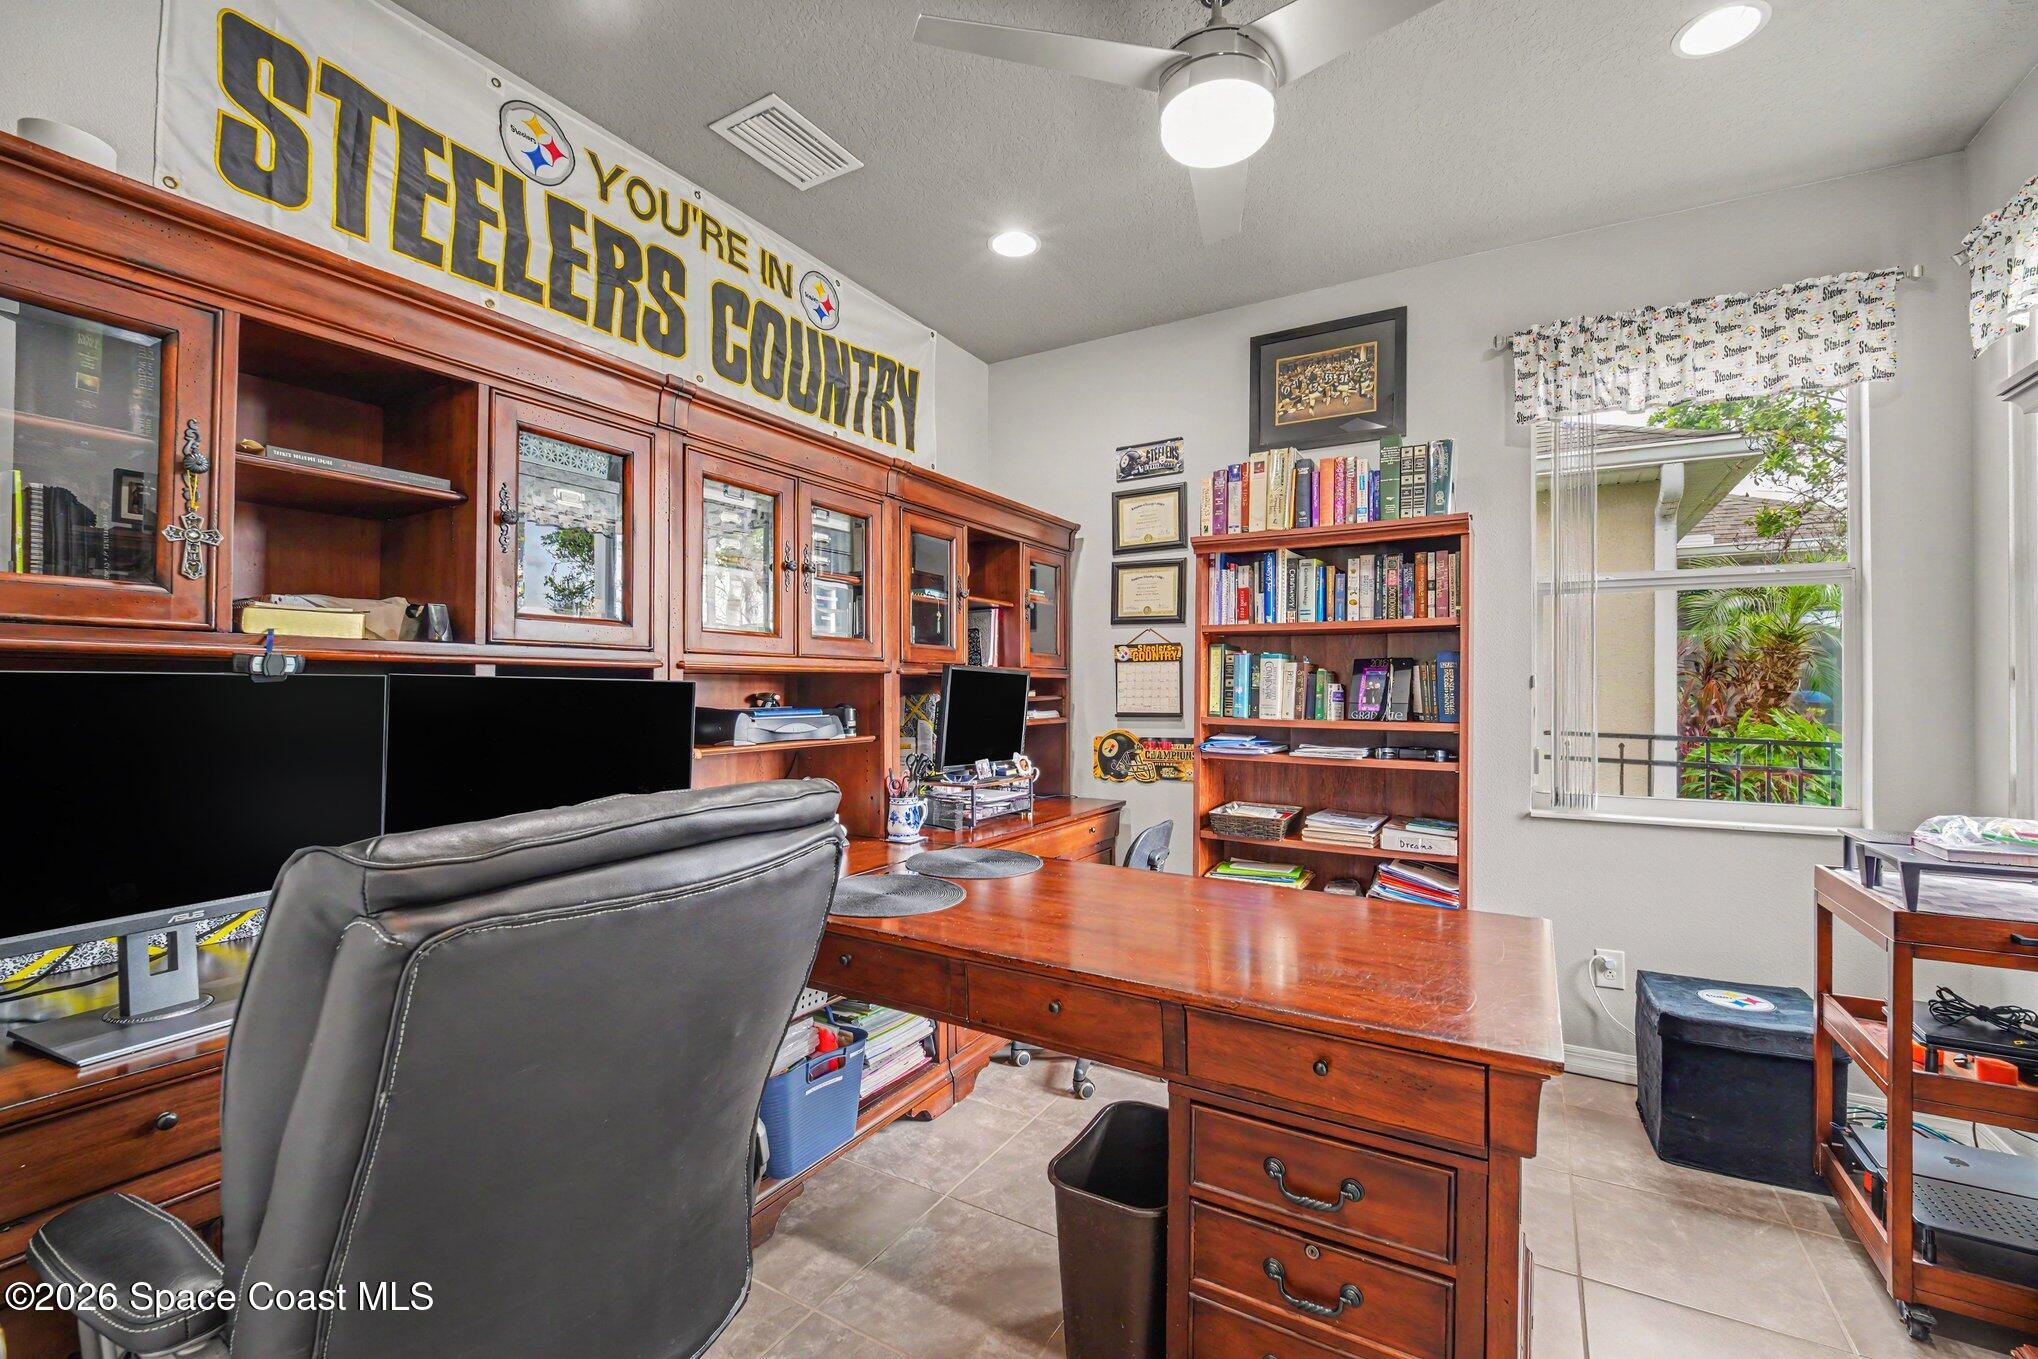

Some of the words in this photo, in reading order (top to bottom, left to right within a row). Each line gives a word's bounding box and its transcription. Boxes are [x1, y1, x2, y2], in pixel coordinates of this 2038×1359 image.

[215, 7, 687, 360] STEELERS
[711, 278, 920, 453] COUNTRY
[585, 147, 749, 274] YOU'RE
[760, 247, 793, 299] IN
[168, 910, 205, 924] ASUS
